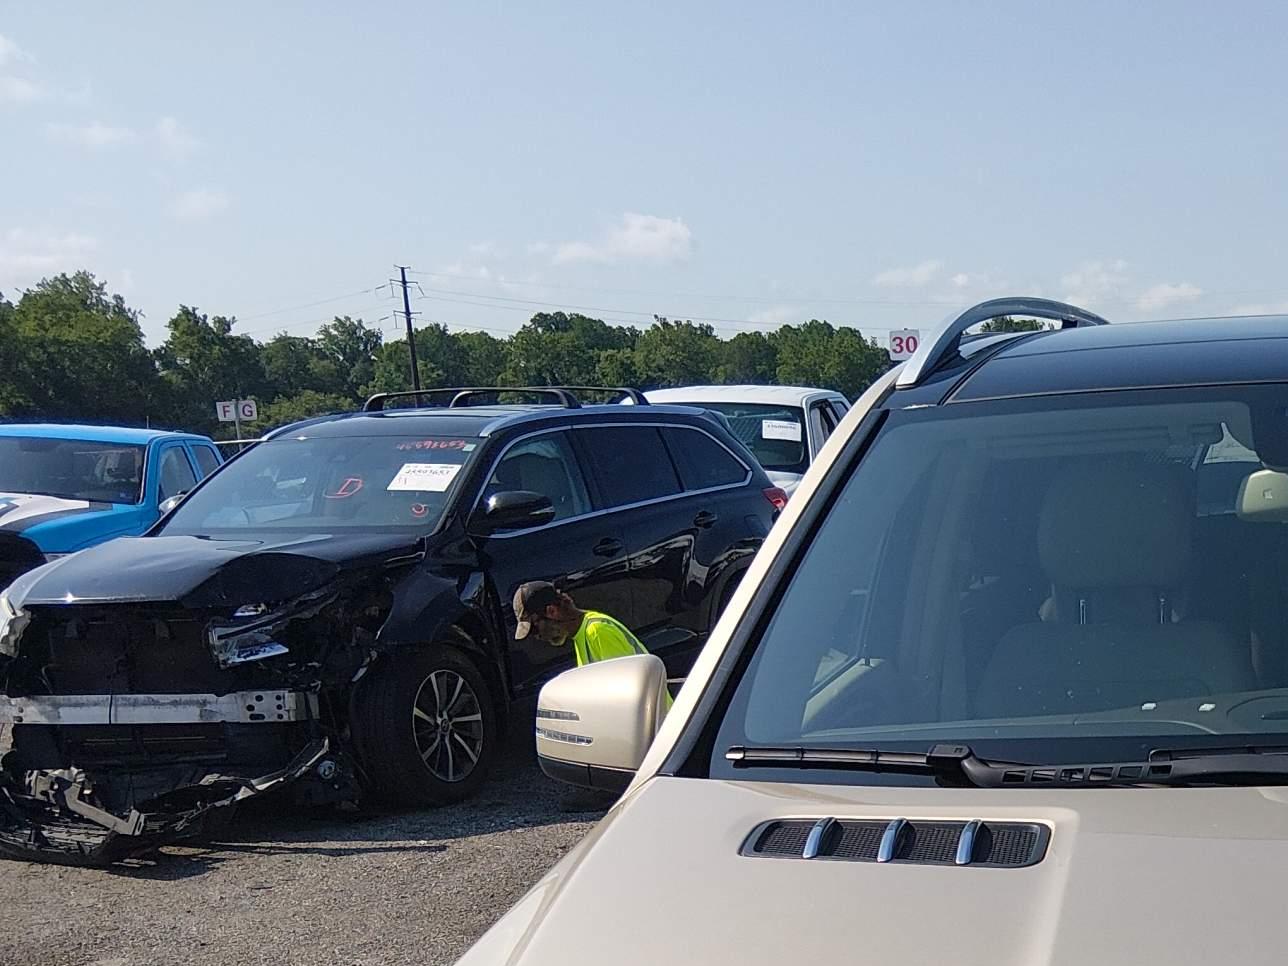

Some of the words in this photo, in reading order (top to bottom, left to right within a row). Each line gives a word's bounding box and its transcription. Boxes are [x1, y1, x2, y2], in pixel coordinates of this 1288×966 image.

[892, 336, 918, 354] 30
[222, 405, 231, 418] F
[242, 403, 254, 418] G
